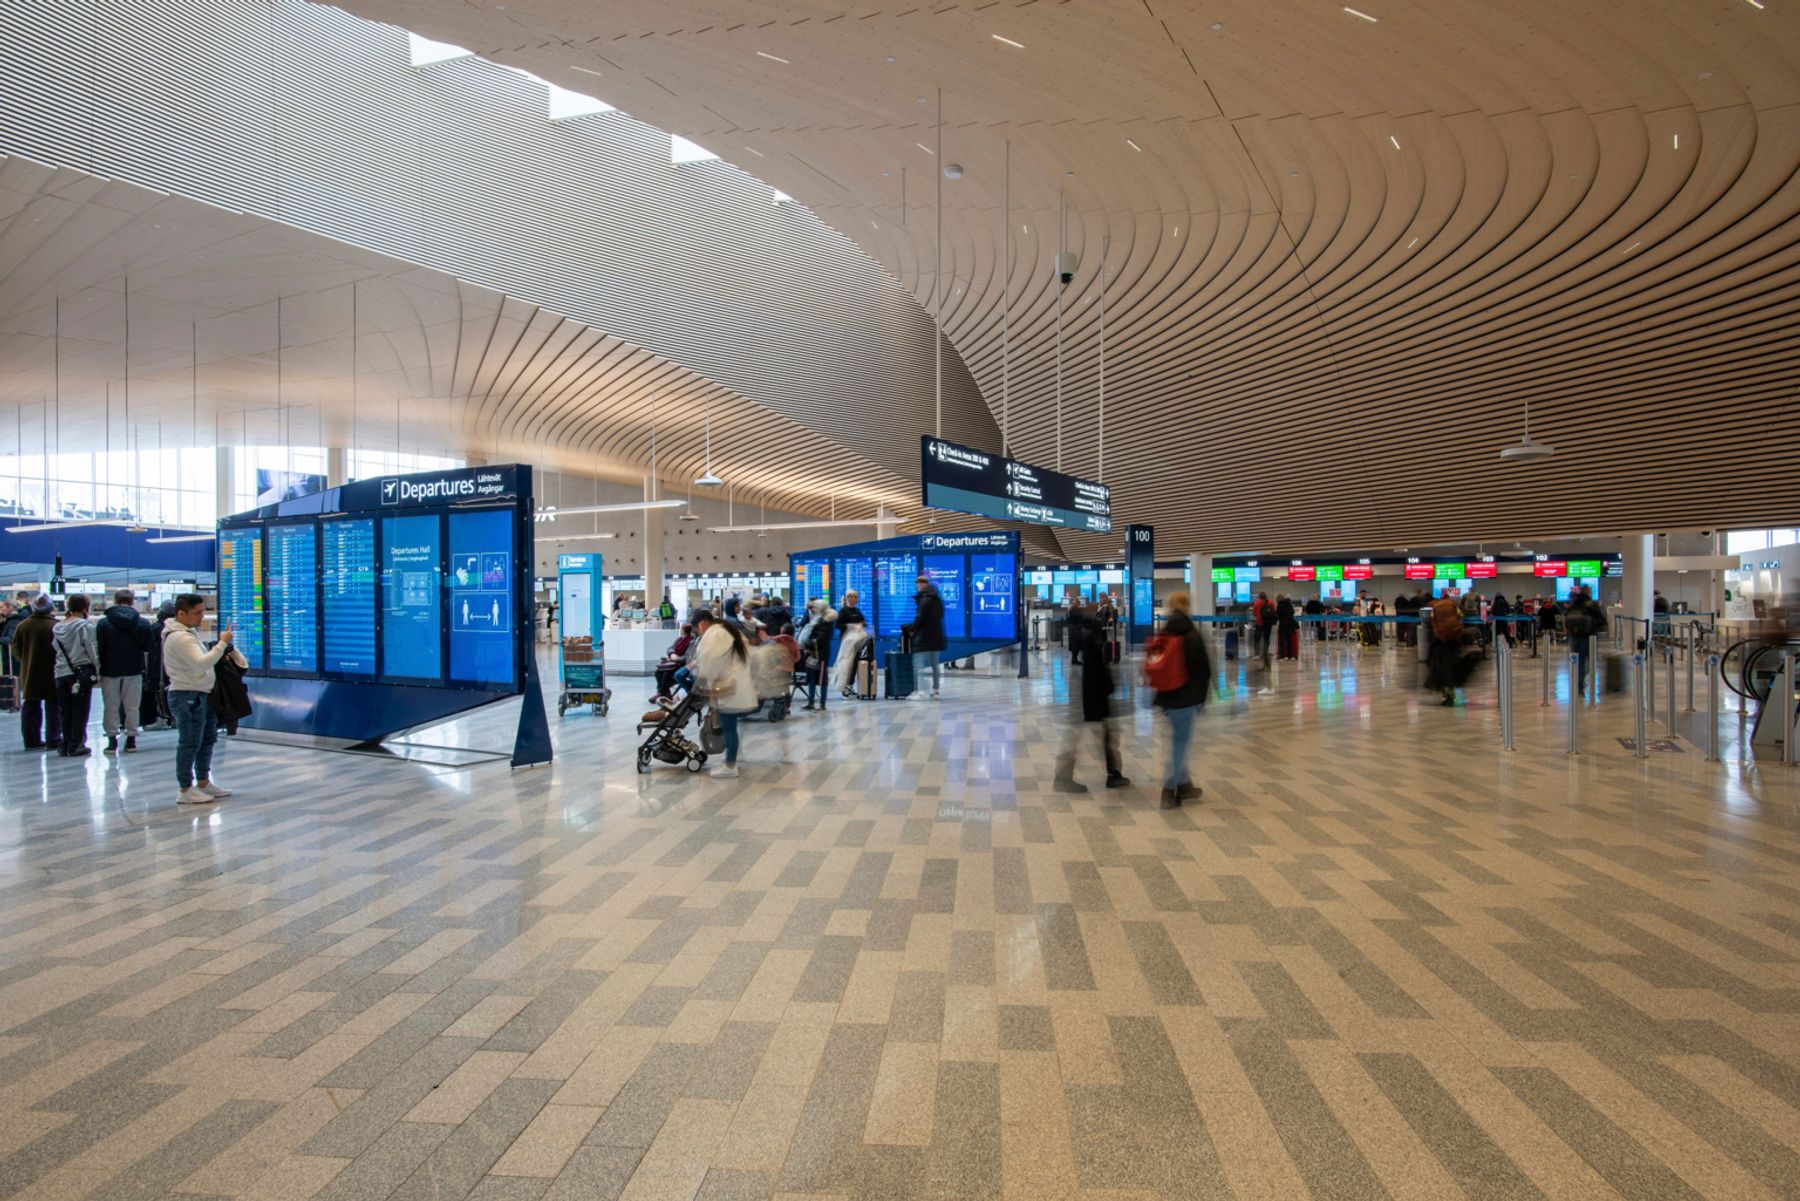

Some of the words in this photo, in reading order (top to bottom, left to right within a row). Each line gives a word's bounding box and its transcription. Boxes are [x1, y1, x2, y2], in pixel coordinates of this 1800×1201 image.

[477, 474, 502, 482] Lähtevät
[400, 479, 475, 502] Departures
[477, 484, 504, 494] Avgångar
[1135, 530, 1150, 542] 100
[936, 536, 988, 548] Departures
[391, 547, 419, 556] Departures
